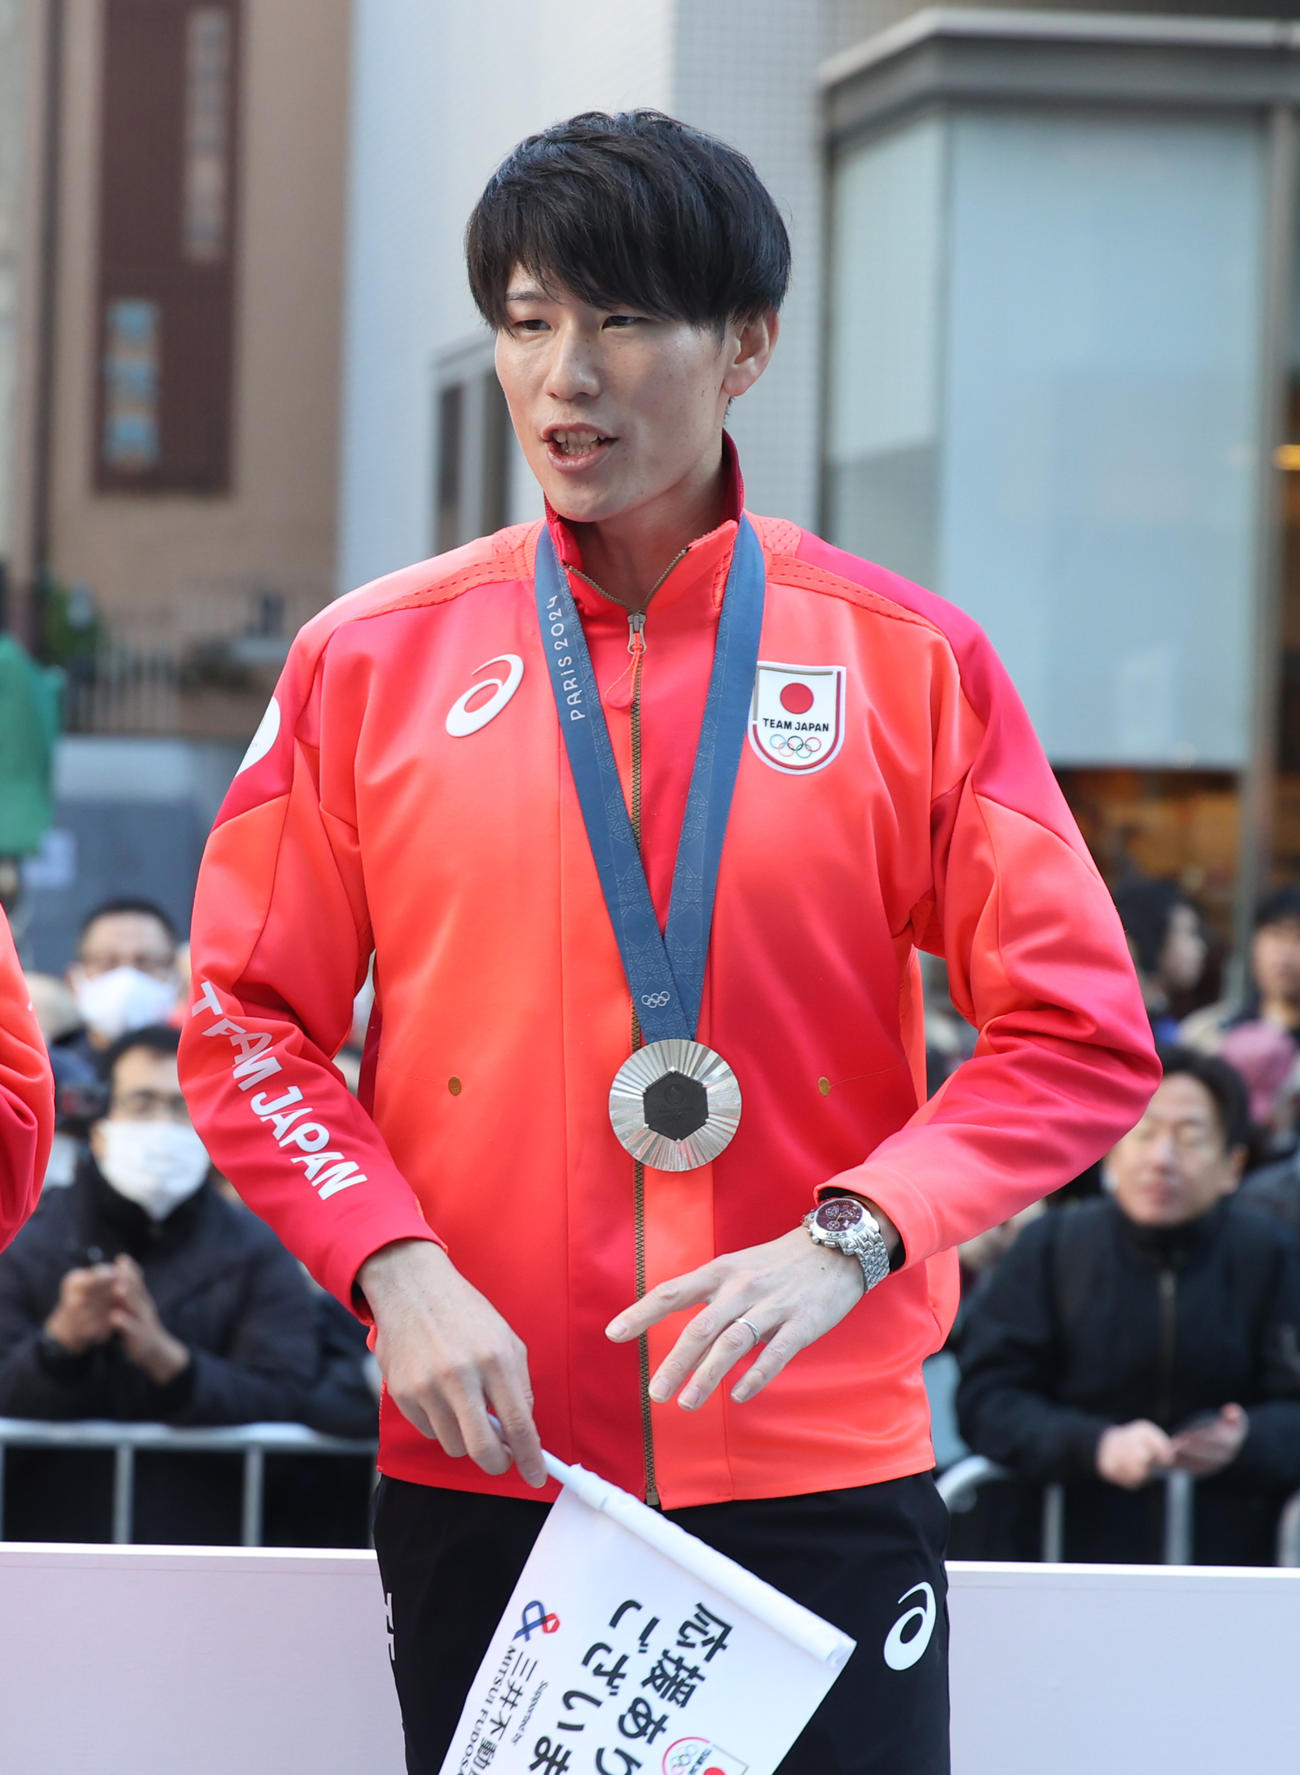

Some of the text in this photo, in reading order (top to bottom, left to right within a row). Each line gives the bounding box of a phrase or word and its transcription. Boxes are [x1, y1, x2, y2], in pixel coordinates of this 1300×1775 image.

[547, 595, 586, 720] PARIS 2024
[763, 718, 829, 732] TEAM JAPAN
[250, 1086, 368, 1200] JAPAN
[468, 1651, 538, 1775] 三井不動
[485, 1645, 516, 1704] MITSUI
